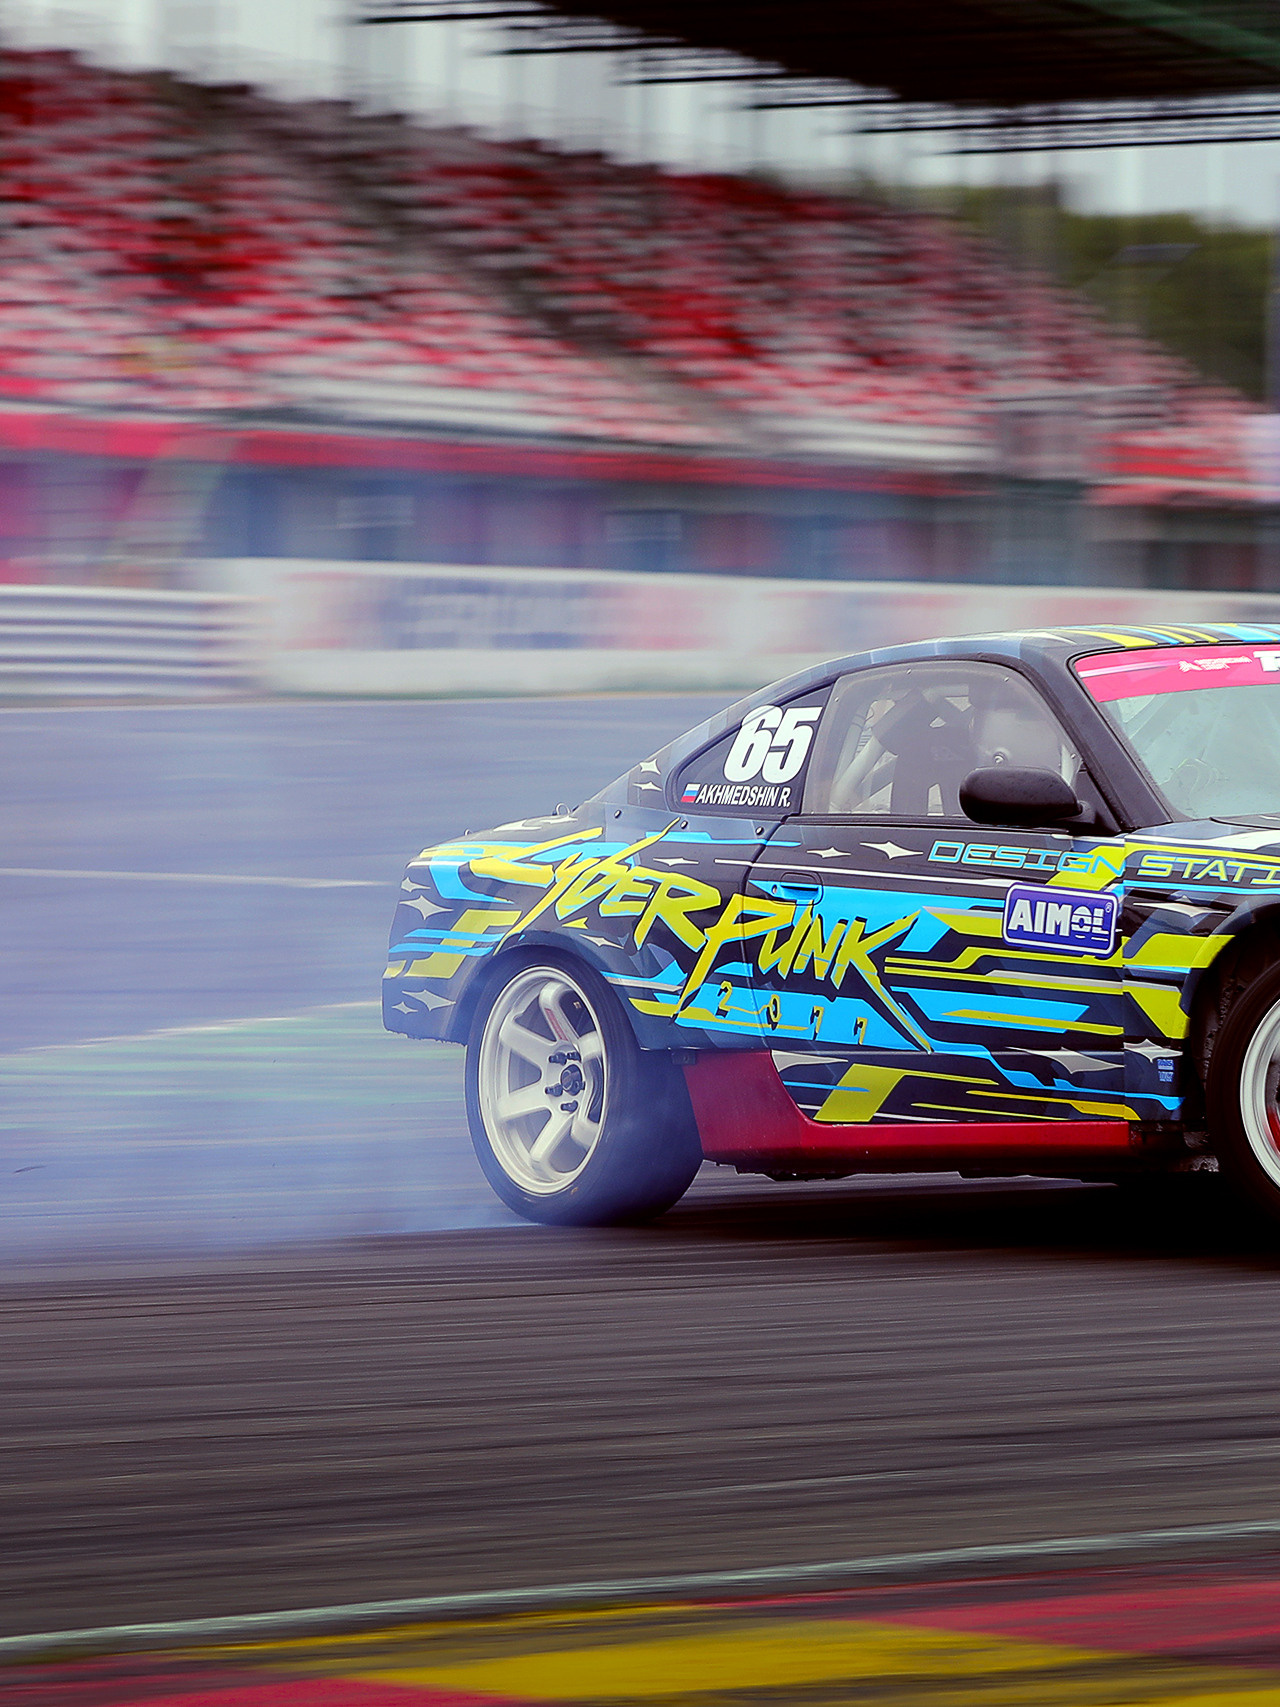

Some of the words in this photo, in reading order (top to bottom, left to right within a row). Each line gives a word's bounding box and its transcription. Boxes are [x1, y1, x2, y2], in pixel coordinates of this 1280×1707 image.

[723, 704, 824, 784] 65
[694, 784, 780, 808] AKHMEDSHIN
[778, 786, 792, 808] R.
[927, 839, 1126, 878] DESIGN
[1007, 898, 1111, 942] AIMOL
